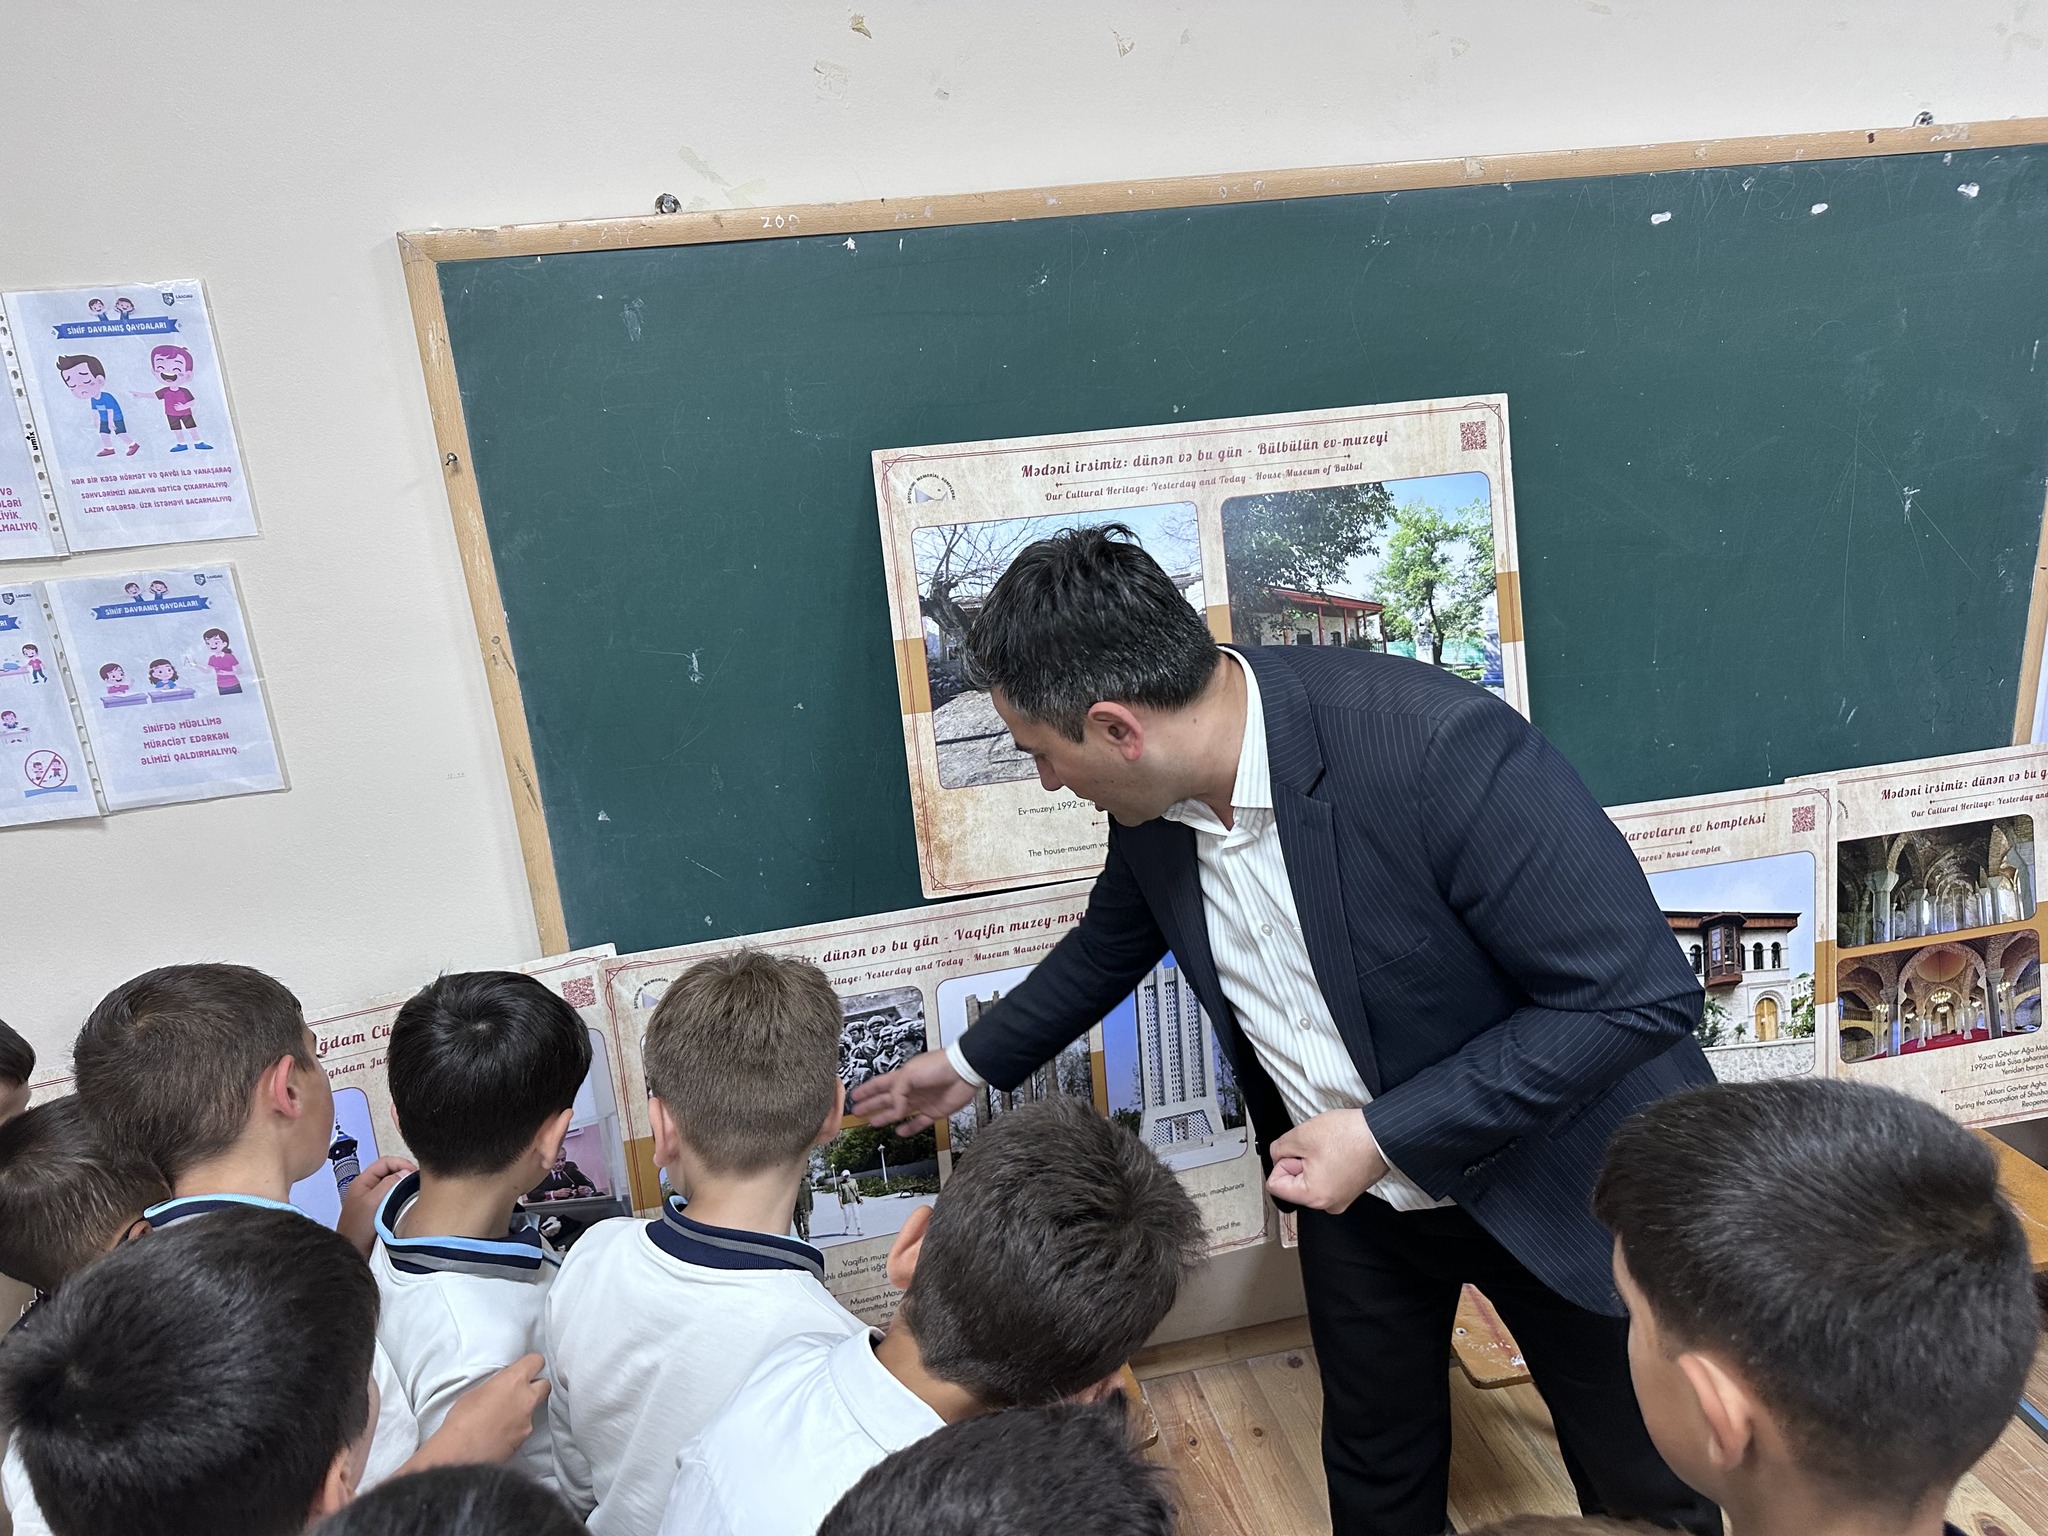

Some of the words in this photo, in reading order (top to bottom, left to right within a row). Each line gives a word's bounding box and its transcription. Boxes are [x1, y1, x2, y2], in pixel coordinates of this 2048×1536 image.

[67, 325, 85, 334] SİNİF
[88, 323, 124, 333] DAVRANIŞ
[126, 321, 167, 333] QAYDALARI
[1022, 462, 1070, 477] Mədəni
[1075, 457, 1128, 473] irsimiz:
[1133, 454, 1173, 467] dünən
[1179, 452, 1192, 462] və
[1198, 448, 1213, 460] bu
[1217, 446, 1242, 462] gün
[1258, 440, 1318, 455] Bülbülün
[1324, 431, 1388, 448] ev-muzeyi
[87, 476, 98, 484] BİR
[120, 472, 146, 481] HÖRMƏT
[148, 471, 158, 479] VƏ
[159, 469, 180, 479] QAYĞI
[181, 468, 192, 476] İLƏ
[193, 466, 232, 475] YANAŞARAQ
[1045, 492, 1062, 501] Our
[1066, 488, 1104, 500] Cultural
[1106, 484, 1149, 496] Heritage:
[1152, 479, 1196, 491] Yesterday
[1199, 476, 1216, 486] and
[1219, 474, 1246, 485] Today
[1256, 468, 1320, 481] House-Museum
[1323, 464, 1331, 475] of
[1334, 462, 1363, 473] Bulbul
[128, 487, 156, 495] ANLAYIB
[158, 484, 182, 493] NƏTİCƏ
[0, 497, 22, 507] LƏRİ
[84, 506, 104, 514] LAZIM
[140, 501, 153, 509] ÜZR
[154, 498, 184, 508] İSTƏMƏYİ
[105, 607, 122, 616] SİNİF
[124, 605, 159, 614] DAVRANIŞ
[160, 600, 199, 611] QAYDALARI
[142, 723, 176, 733] SİNİFDƏ
[179, 717, 222, 729] MÜƏLLİMƏ
[143, 737, 187, 749] MÜRACİƏT
[190, 732, 230, 744] EDƏRKƏN
[141, 753, 171, 765] ƏLİMİZİ
[1881, 785, 1921, 800] Mədəni
[1924, 779, 1968, 794] irsimiz:
[1972, 774, 2005, 788] dünən
[2009, 773, 2020, 782] və
[2024, 769, 2037, 780] bu
[2040, 768, 2048, 780] g
[1018, 805, 1055, 815] Ev-muzeyi
[1057, 801, 1085, 810] 1992-ci
[1911, 809, 1925, 818] Our
[1927, 805, 1958, 816] Cultural
[1960, 800, 1994, 811] Heritage:
[1997, 792, 2033, 805] Yesterday
[1690, 823, 1702, 833] ev
[1706, 813, 1766, 832] kompleksi
[1044, 843, 1097, 855] house-museum
[1666, 848, 1689, 859] house
[1691, 845, 1721, 856] complex
[823, 947, 866, 963] dünən
[872, 945, 886, 955] və
[892, 941, 908, 952] bu
[913, 935, 939, 951] gün
[955, 923, 1004, 941] Vaqifin
[1010, 911, 1086, 932] muzey-məq
[830, 976, 862, 987] ritage:
[865, 965, 912, 980] Yesterday
[915, 962, 933, 972] and
[936, 957, 964, 969] Today
[973, 950, 1010, 962] Museum
[319, 1033, 365, 1054] ğdam
[2021, 1047, 2034, 1055] Ağa
[327, 1062, 365, 1079] ghdam
[1971, 1063, 1994, 1072] 1992-ci
[2006, 1083, 2029, 1092] Govhar
[2030, 1081, 2047, 1089] Agha
[1955, 1102, 1975, 1110] During
[1986, 1093, 2019, 1105] occupation
[1216, 1223, 1229, 1232] and
[1230, 1220, 1241, 1228] the
[842, 1256, 868, 1267] Vaqifin
[850, 1294, 881, 1306] Museum
[850, 1300, 888, 1315] committed
